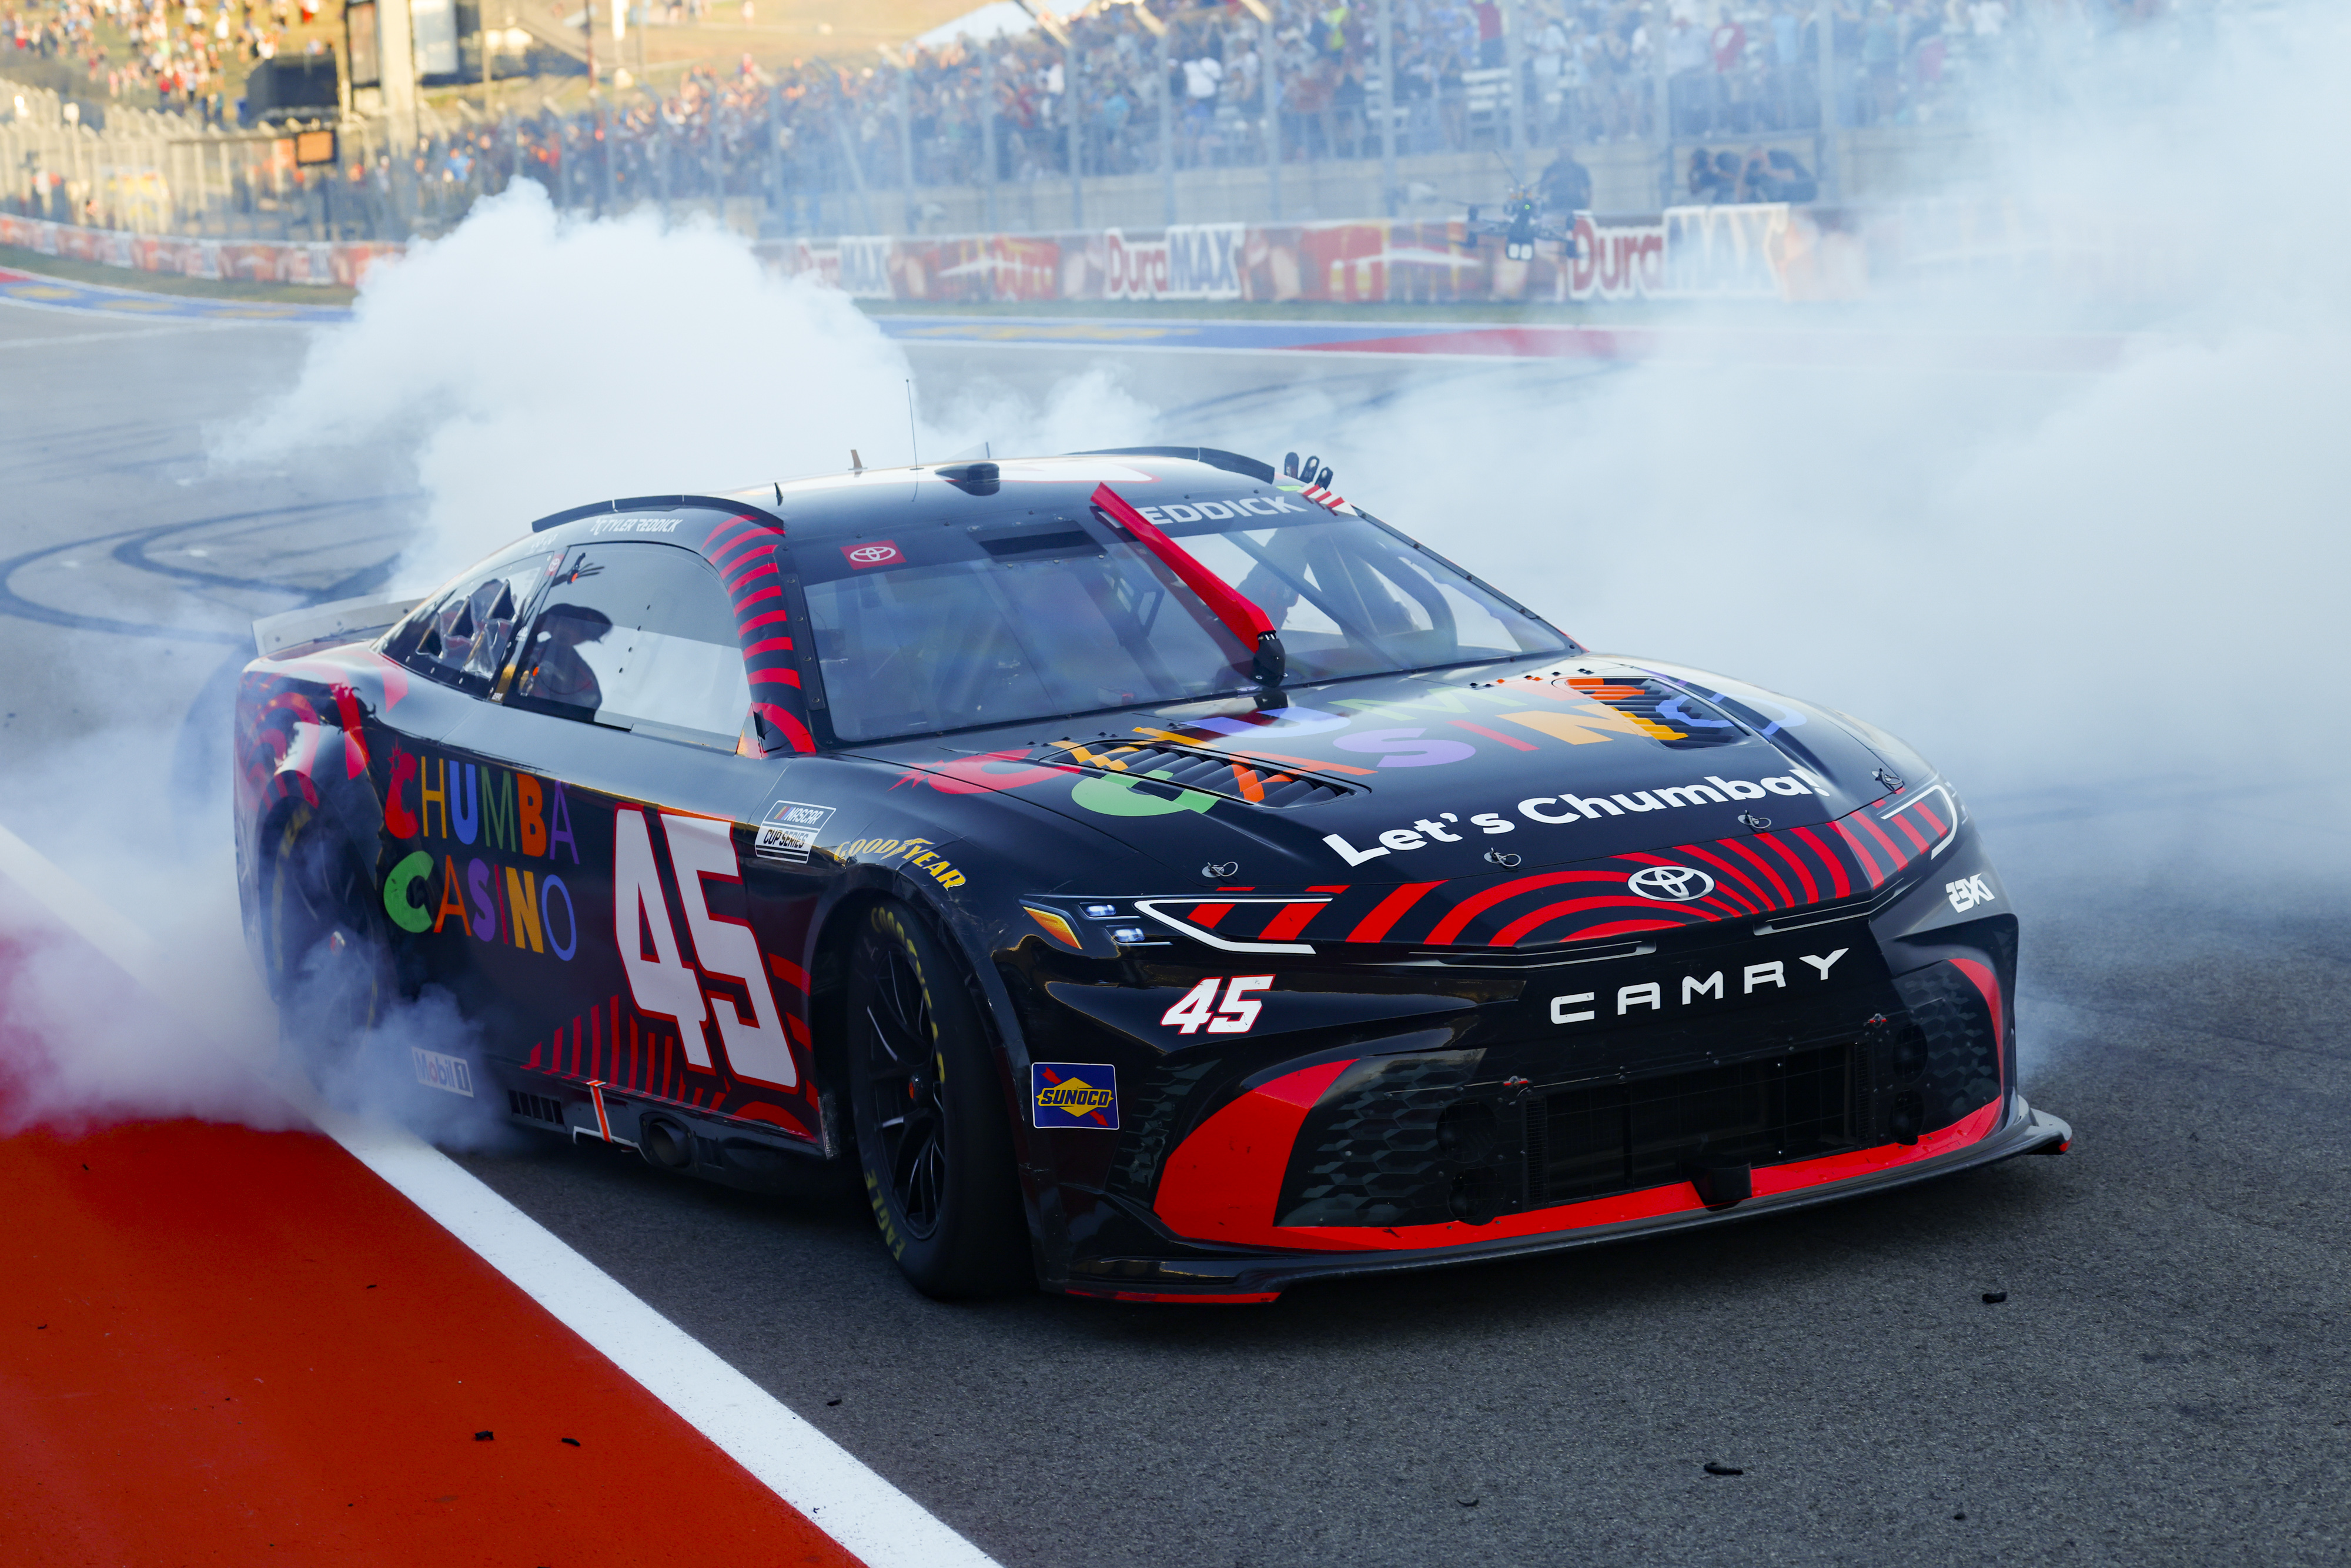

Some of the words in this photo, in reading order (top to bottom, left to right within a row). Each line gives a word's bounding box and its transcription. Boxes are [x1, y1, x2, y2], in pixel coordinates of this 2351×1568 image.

[602, 519, 638, 532] TYLER
[385, 738, 580, 865] CHUMBA
[784, 807, 824, 825] NASCAR
[1322, 812, 1515, 867] Let's
[1517, 769, 1830, 824] Chumba!
[763, 829, 784, 845] CUP
[780, 830, 810, 849] SERIES
[383, 850, 577, 961] CASINO
[614, 803, 799, 1092] 45
[1161, 975, 1275, 1034] 45
[1550, 948, 1849, 1025] CAMRY
[413, 1051, 456, 1089] Mobil
[1041, 1089, 1110, 1106] SUNOCO
